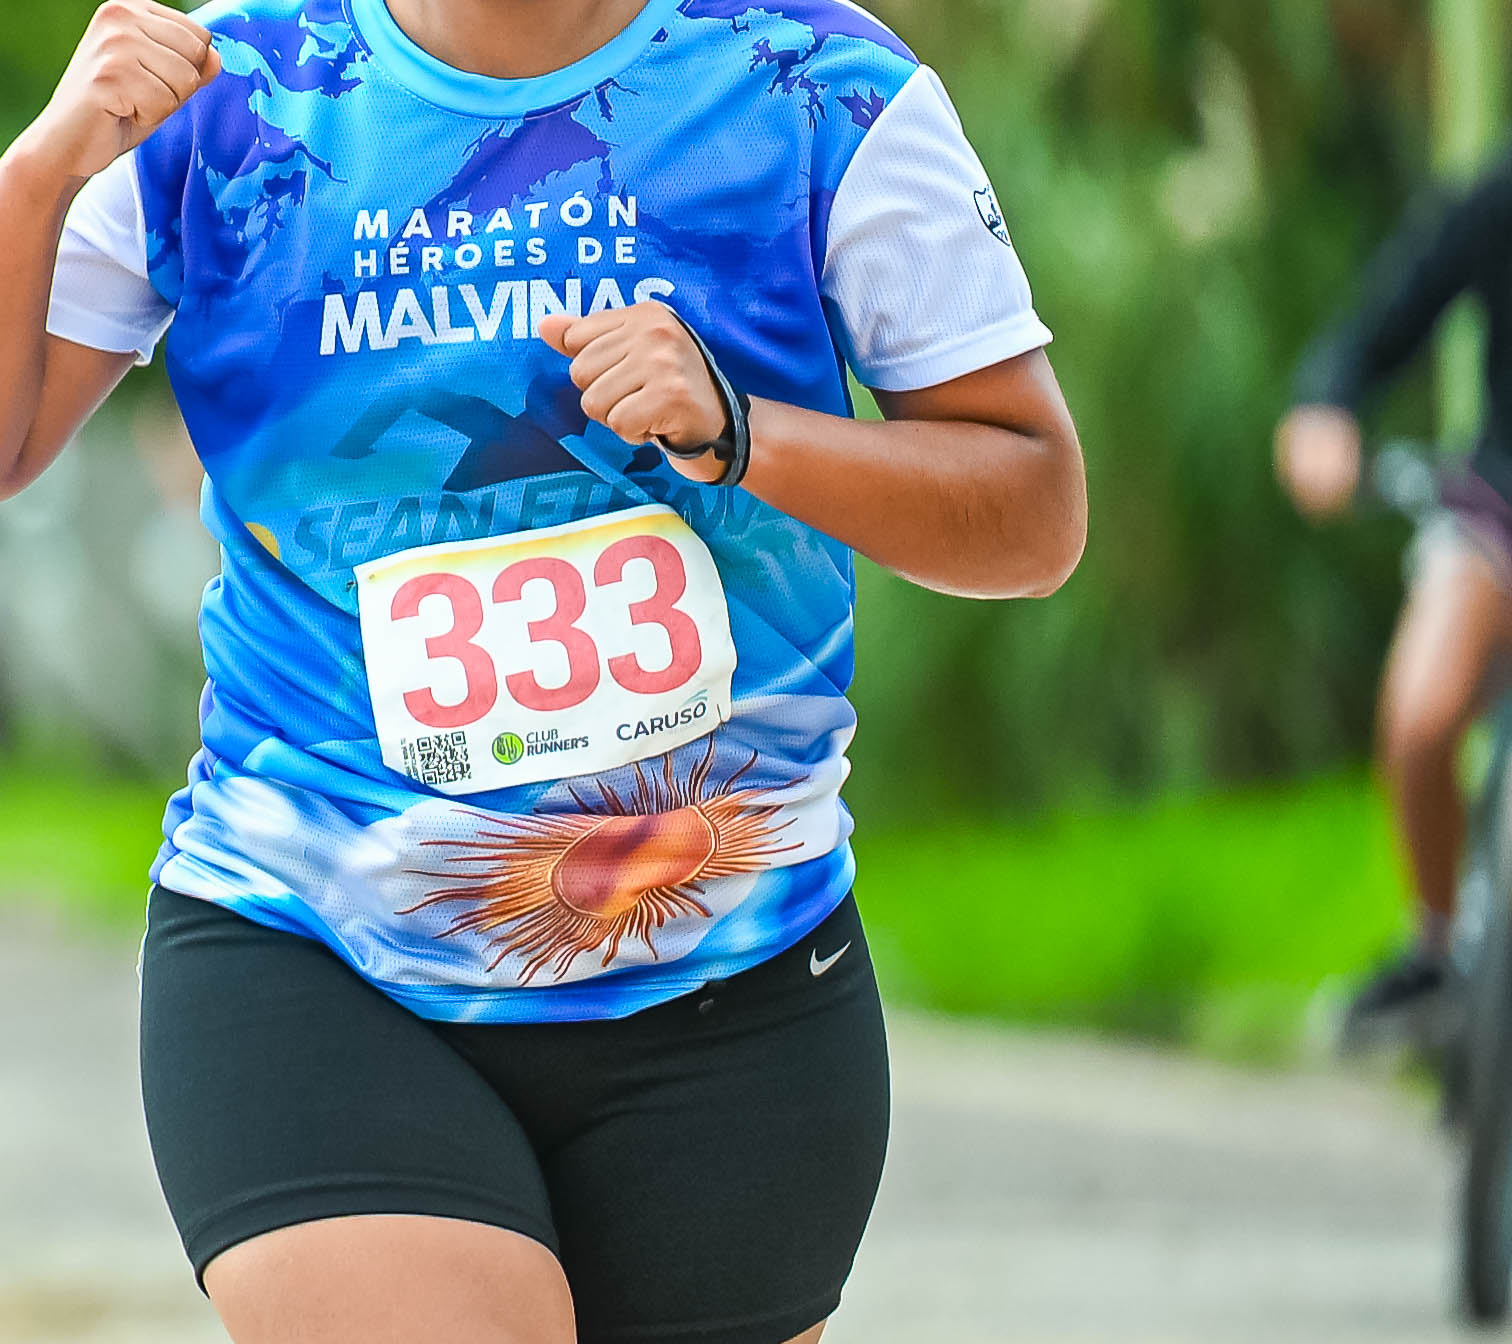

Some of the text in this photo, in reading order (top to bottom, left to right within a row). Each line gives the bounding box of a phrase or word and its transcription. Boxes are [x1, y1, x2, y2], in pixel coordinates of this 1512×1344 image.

[353, 191, 637, 240] MARATÓN
[354, 236, 637, 277] HÉROES DE
[390, 534, 703, 728] 333
[526, 728, 559, 744] CLUB
[616, 701, 707, 741] CARUSO
[526, 736, 590, 757] RUNNER'S
